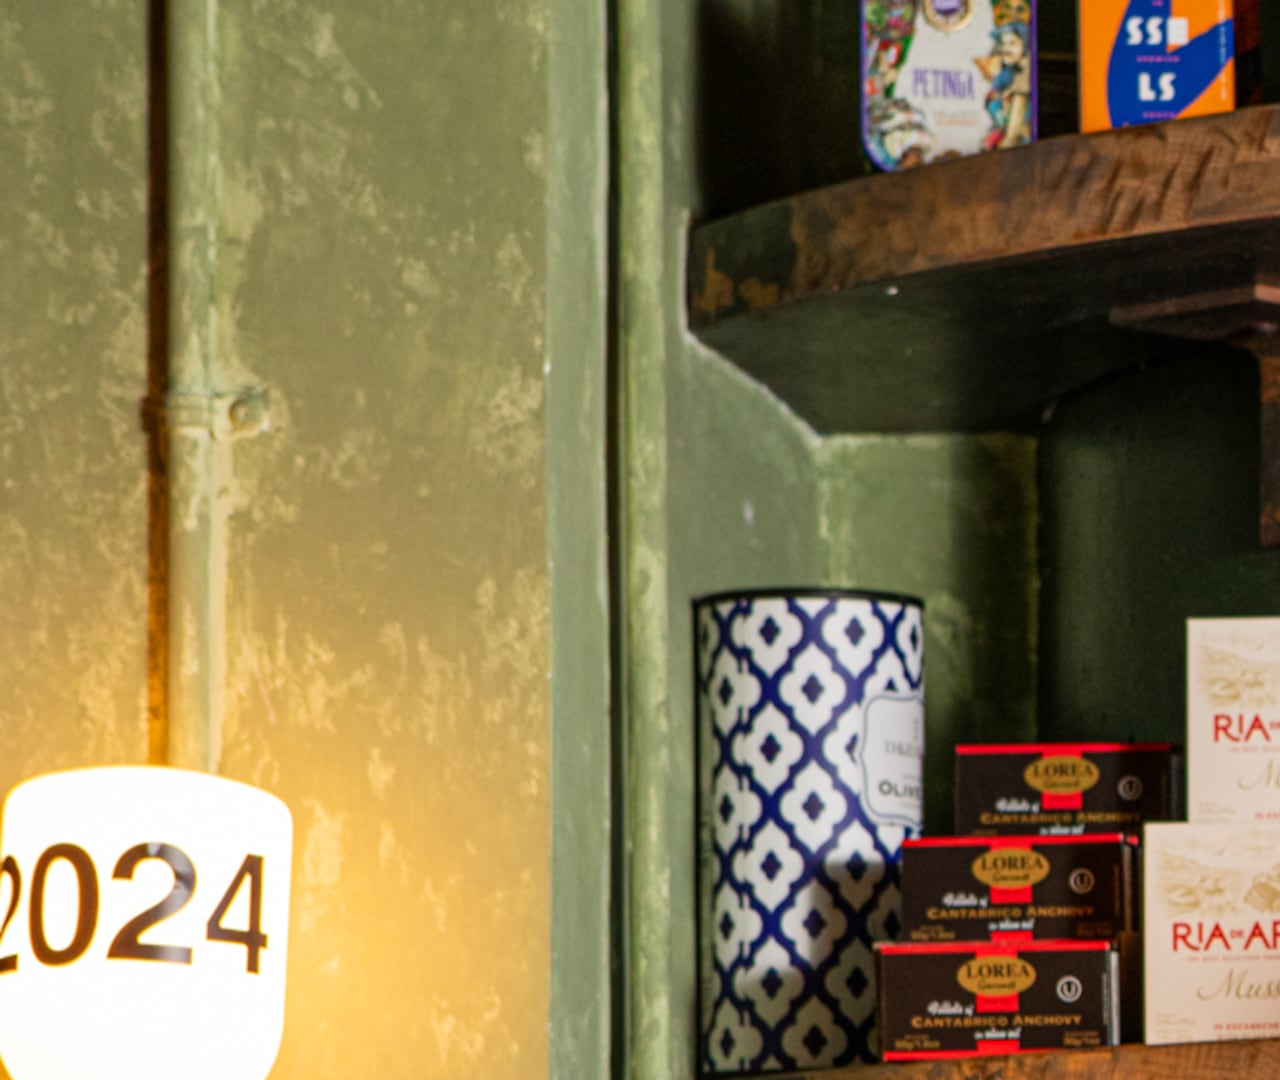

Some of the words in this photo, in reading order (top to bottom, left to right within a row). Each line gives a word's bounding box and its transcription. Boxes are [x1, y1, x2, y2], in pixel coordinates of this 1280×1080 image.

[912, 67, 975, 100] PETINGA
[1138, 72, 1176, 101] LS
[1213, 713, 1270, 742] RIA
[1032, 764, 1093, 778] LOREA
[980, 812, 1072, 825] CANTABRICO
[980, 856, 1044, 871] LOREA
[0, 841, 269, 974] 2024
[927, 906, 1022, 920] CANTABRICO
[1027, 905, 1095, 918] ANCHOVY
[1172, 921, 1231, 952] RIA
[966, 963, 1031, 979] LOREA
[911, 1015, 1009, 1028] CANTABRICO
[1012, 1014, 1082, 1026] ANCHOVY
